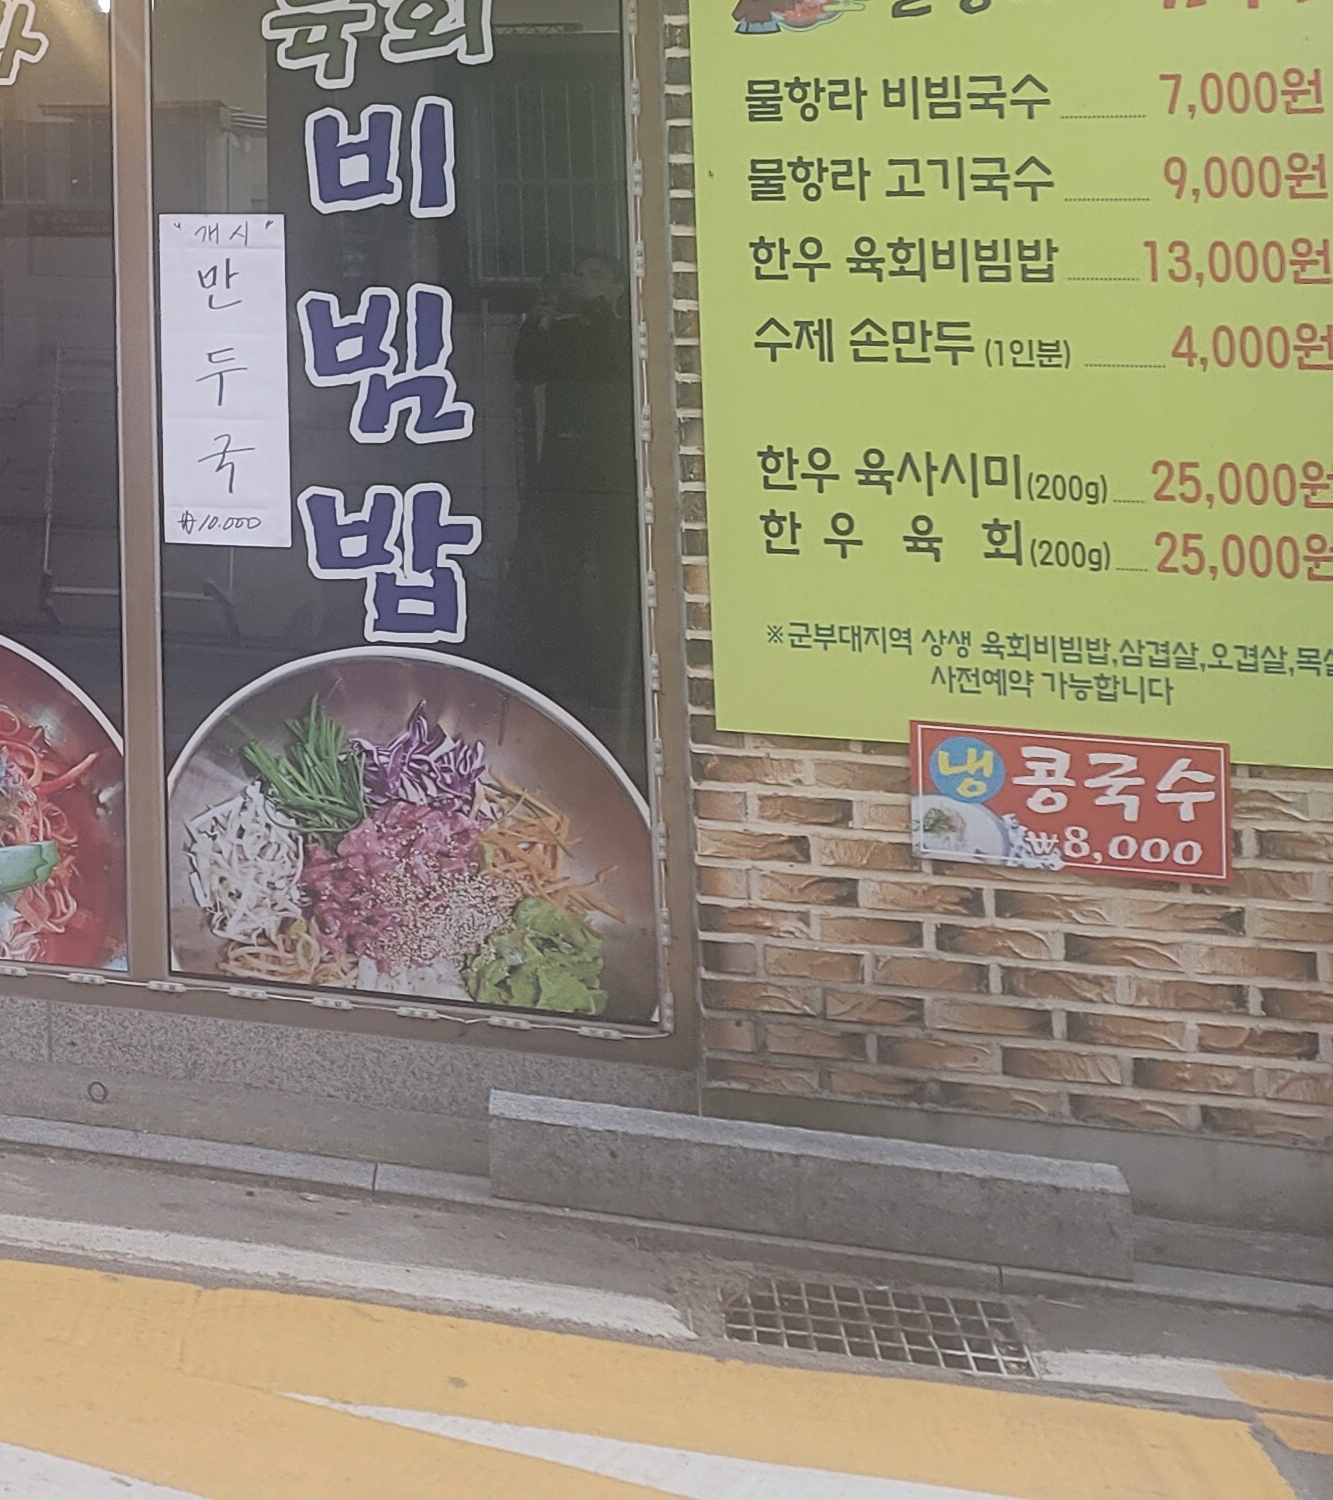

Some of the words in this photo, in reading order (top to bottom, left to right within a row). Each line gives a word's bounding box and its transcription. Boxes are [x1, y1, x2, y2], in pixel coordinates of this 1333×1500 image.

[745, 77, 867, 121] 물항라
[883, 74, 1051, 120] 비빔국수
[1159, 67, 1326, 119] 7,000원
[748, 157, 871, 202] 물항라
[885, 155, 1054, 203] 고기국수
[1164, 153, 1329, 202] 9,000원
[749, 236, 831, 282] 한우
[846, 237, 1059, 284] 육회비빔밥
[1143, 237, 1333, 286] 13,000원
[297, 96, 482, 644] 비빔밥
[753, 317, 834, 364] 수제
[849, 317, 975, 365] 손만두
[1172, 324, 1333, 372] 4,000원
[195, 257, 255, 494] 만두국
[757, 445, 840, 494] 한우
[1151, 460, 1333, 510] 25,000원
[1155, 531, 1333, 582] 25,000원
[921, 628, 972, 660] 상생
[930, 667, 1034, 700] 사전예약
[1048, 673, 1174, 706] 가능합니다
[938, 750, 994, 797] 냉
[1012, 746, 1216, 823] 콩국수
